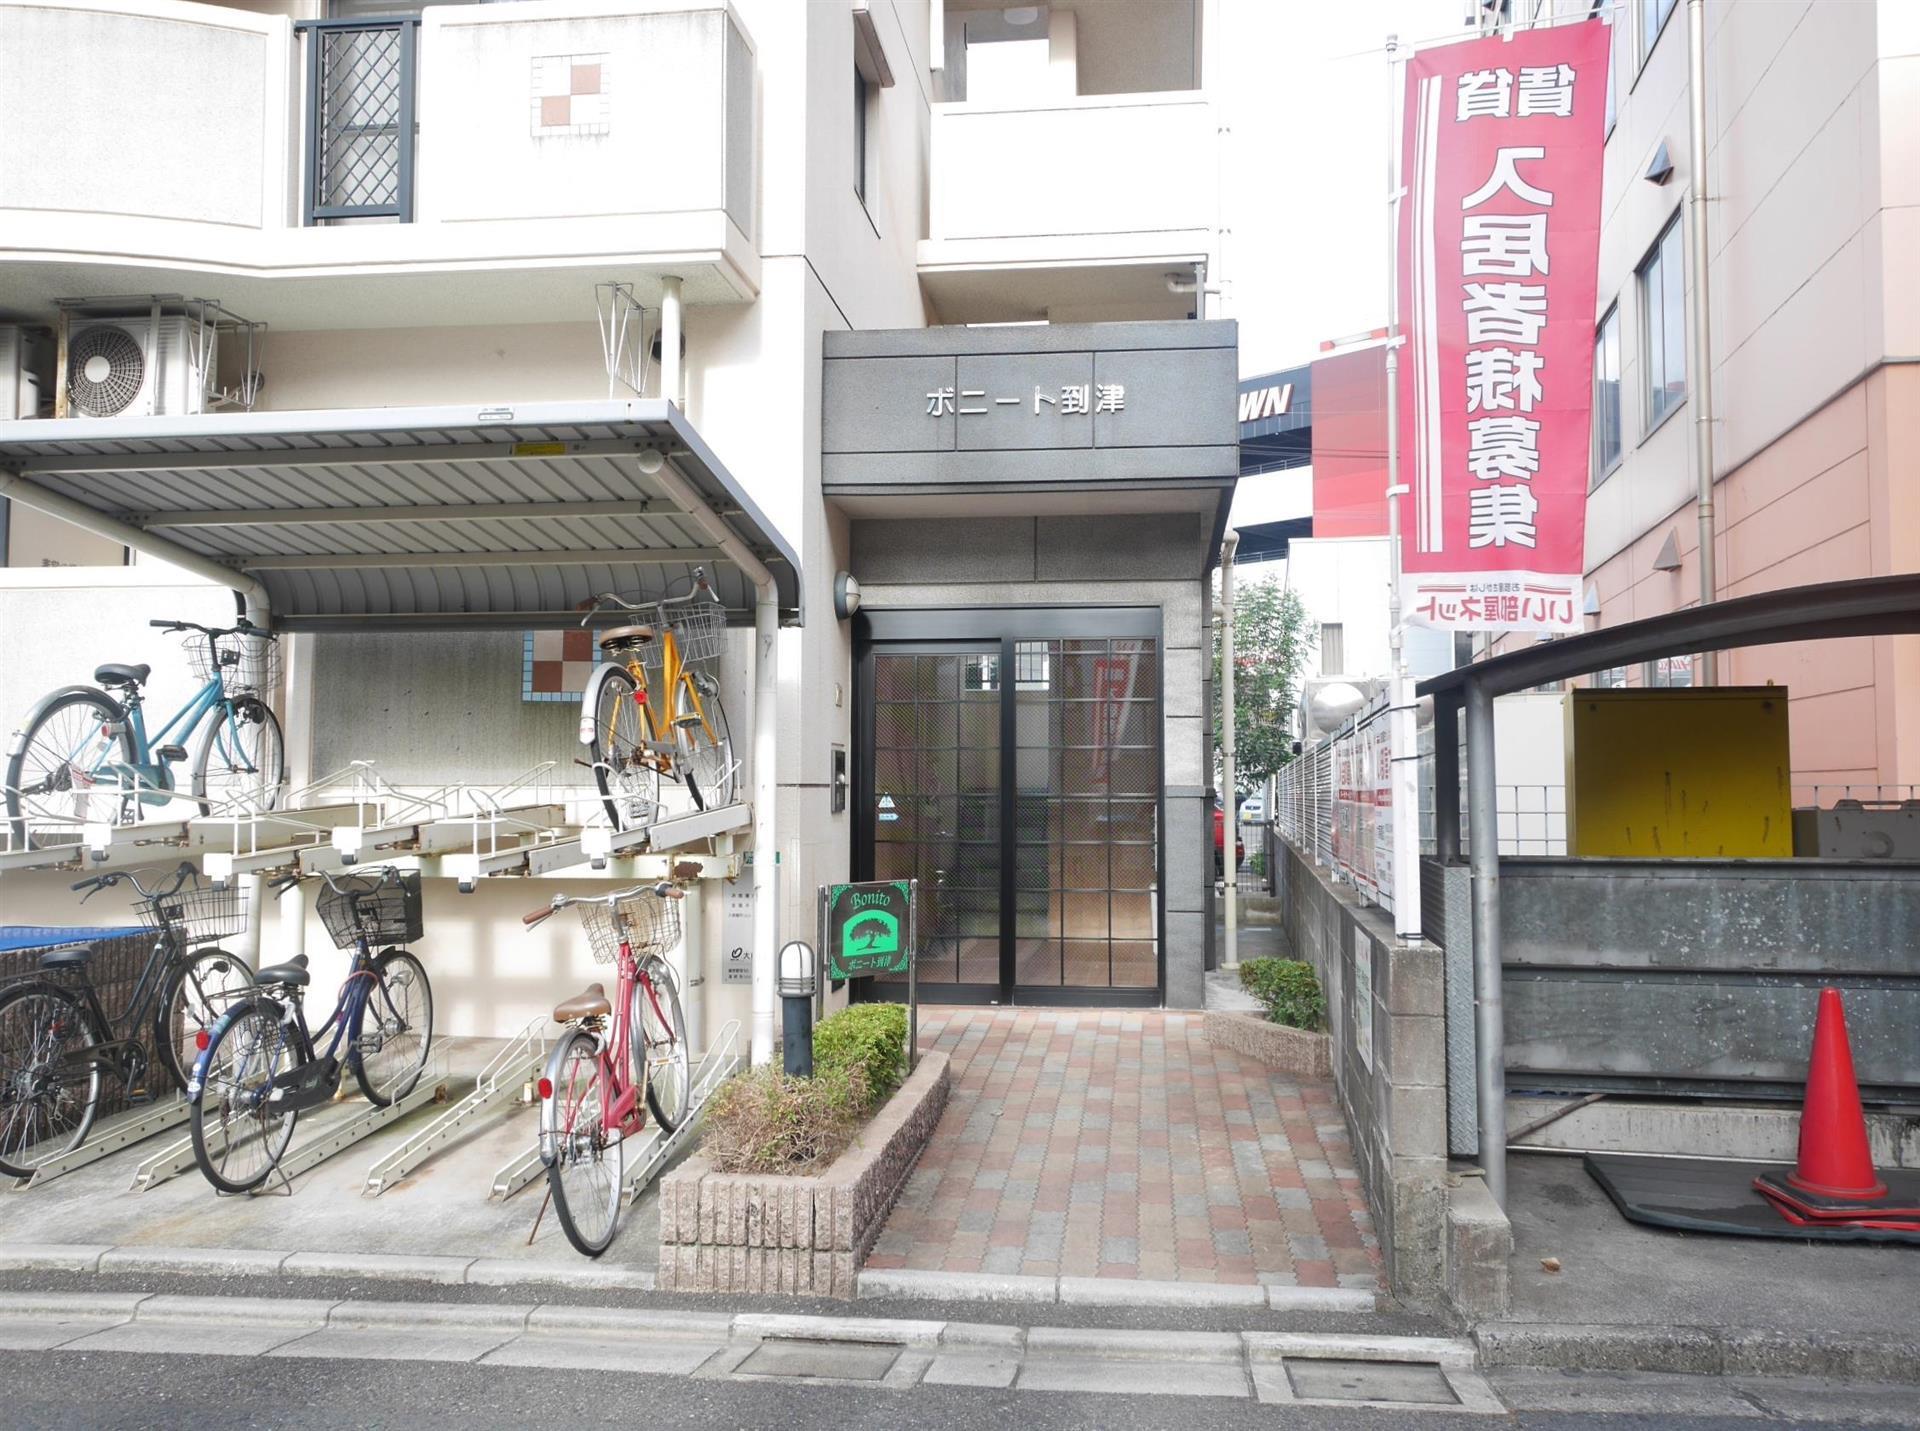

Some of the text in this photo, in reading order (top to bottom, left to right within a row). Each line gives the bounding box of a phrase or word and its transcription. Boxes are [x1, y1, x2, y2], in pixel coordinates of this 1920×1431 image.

[926, 384, 1125, 417] ボニート到津
[850, 889, 891, 909] Bonito
